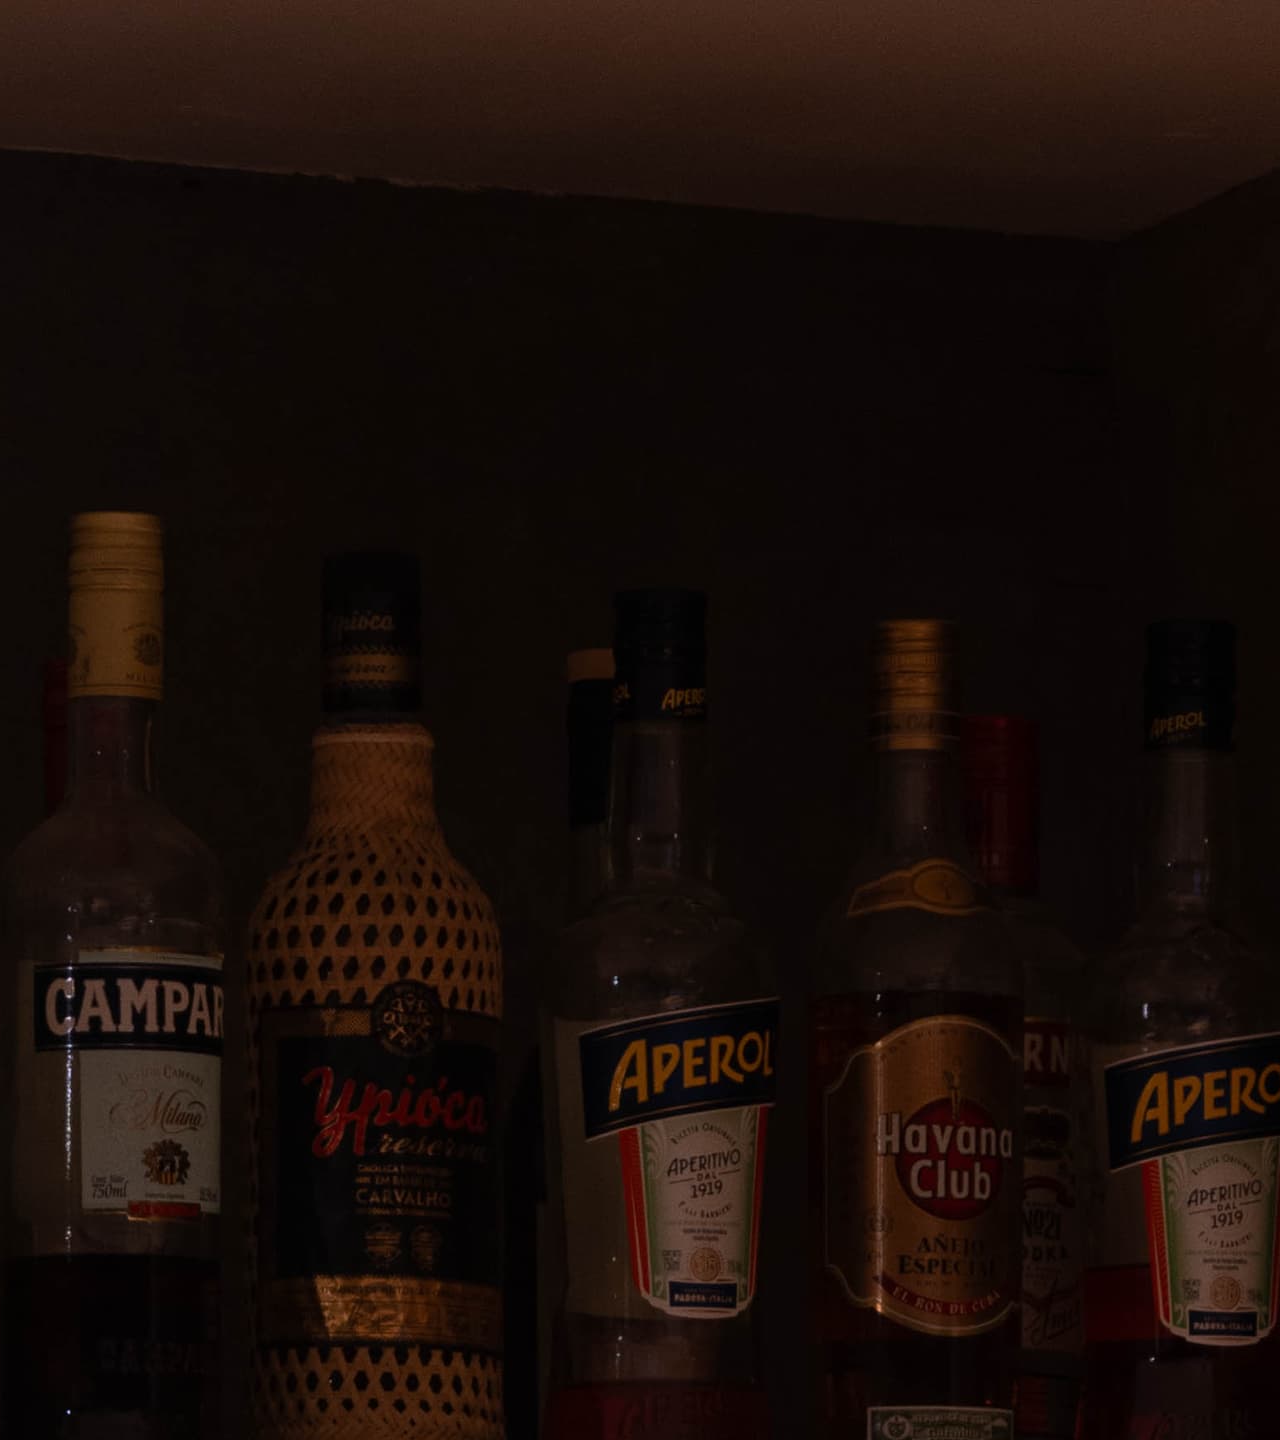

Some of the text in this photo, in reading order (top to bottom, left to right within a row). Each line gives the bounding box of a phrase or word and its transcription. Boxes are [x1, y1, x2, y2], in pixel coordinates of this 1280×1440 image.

[607, 1028, 774, 1112] APEROL
[300, 1064, 488, 1160] Ypióca
[877, 1112, 1013, 1158] Havana
[667, 1148, 741, 1176] APERITIVO
[691, 1181, 723, 1199] 1919
[696, 1172, 717, 1181] DAL
[910, 1158, 992, 1200] Club
[354, 1188, 452, 1208] CARVALHO
[1187, 1180, 1262, 1208] APERITIVO
[1216, 1204, 1237, 1212] DAL
[1211, 1211, 1243, 1229] 1919
